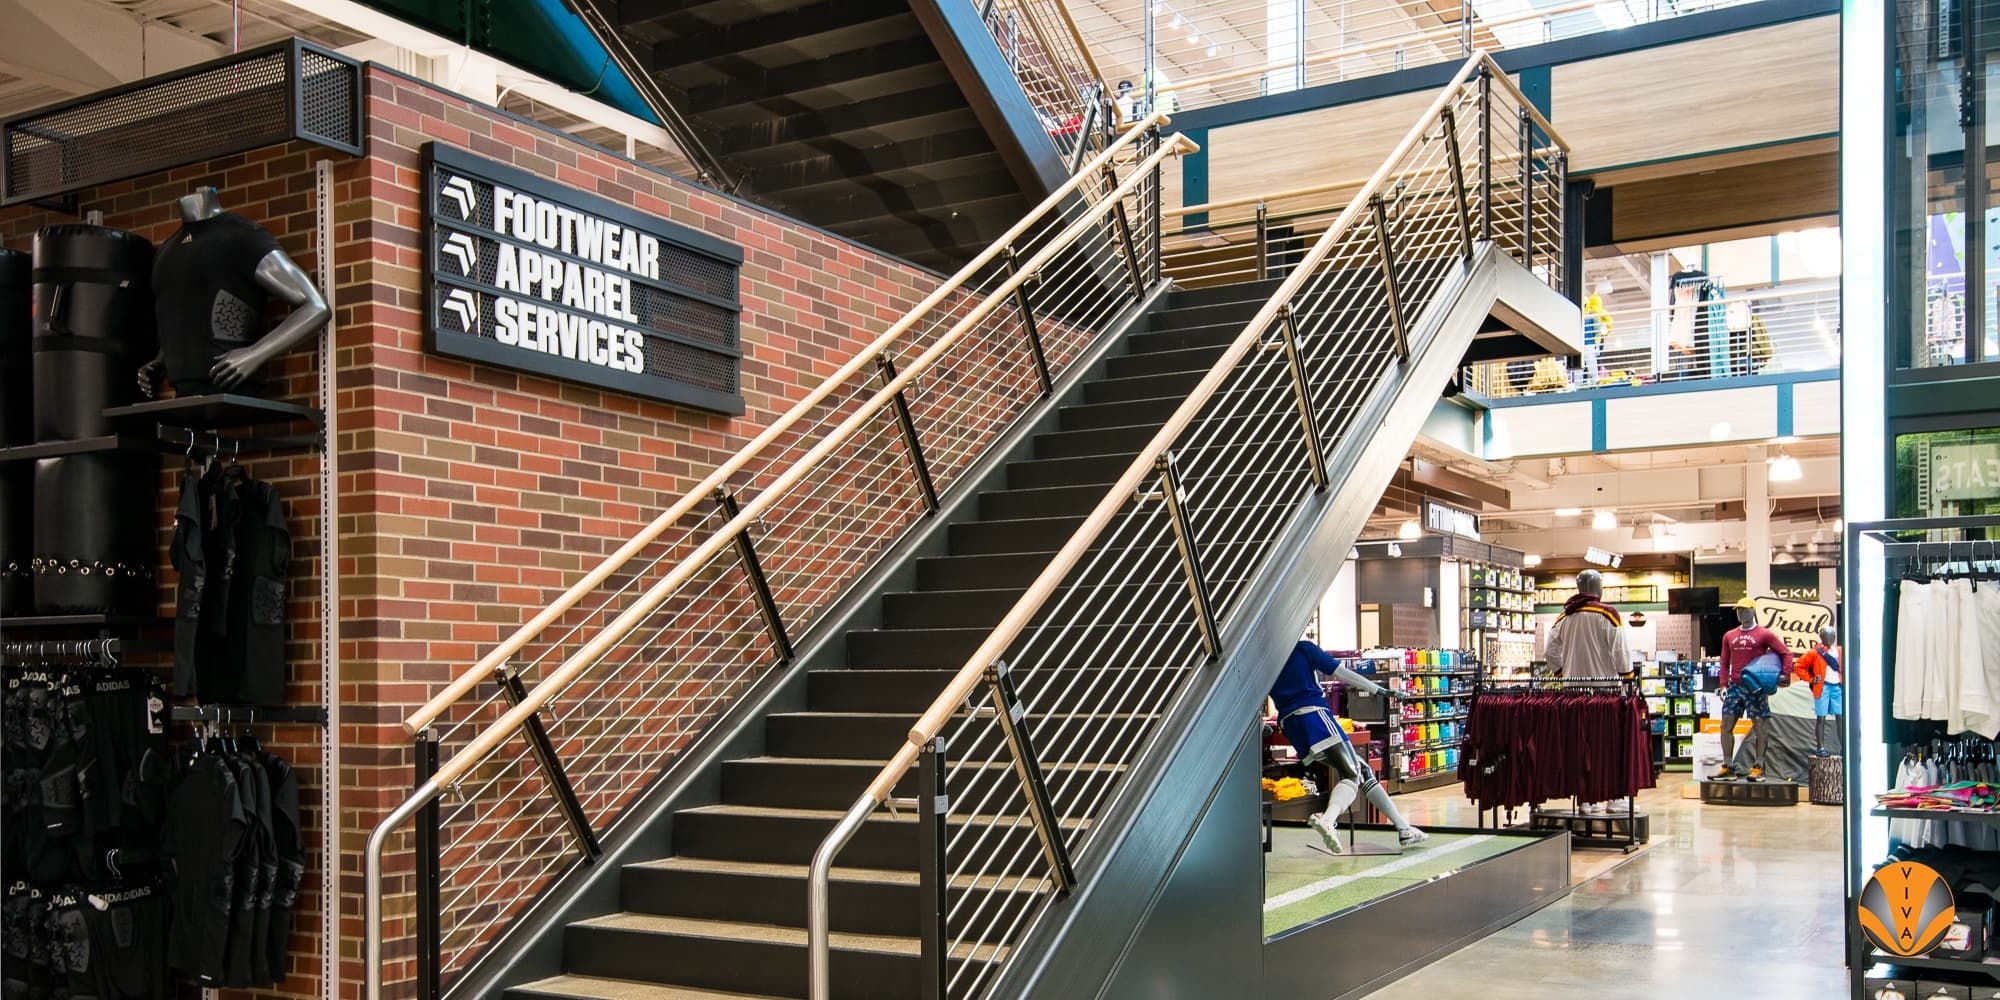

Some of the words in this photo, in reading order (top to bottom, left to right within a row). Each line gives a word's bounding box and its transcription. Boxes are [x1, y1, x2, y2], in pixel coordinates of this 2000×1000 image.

[494, 186, 659, 280] FOOTWEAR
[495, 241, 638, 324] APPAREL
[495, 298, 644, 374] SERVICES
[1763, 606, 1830, 635] Trail
[96, 680, 130, 692] ADIDAS
